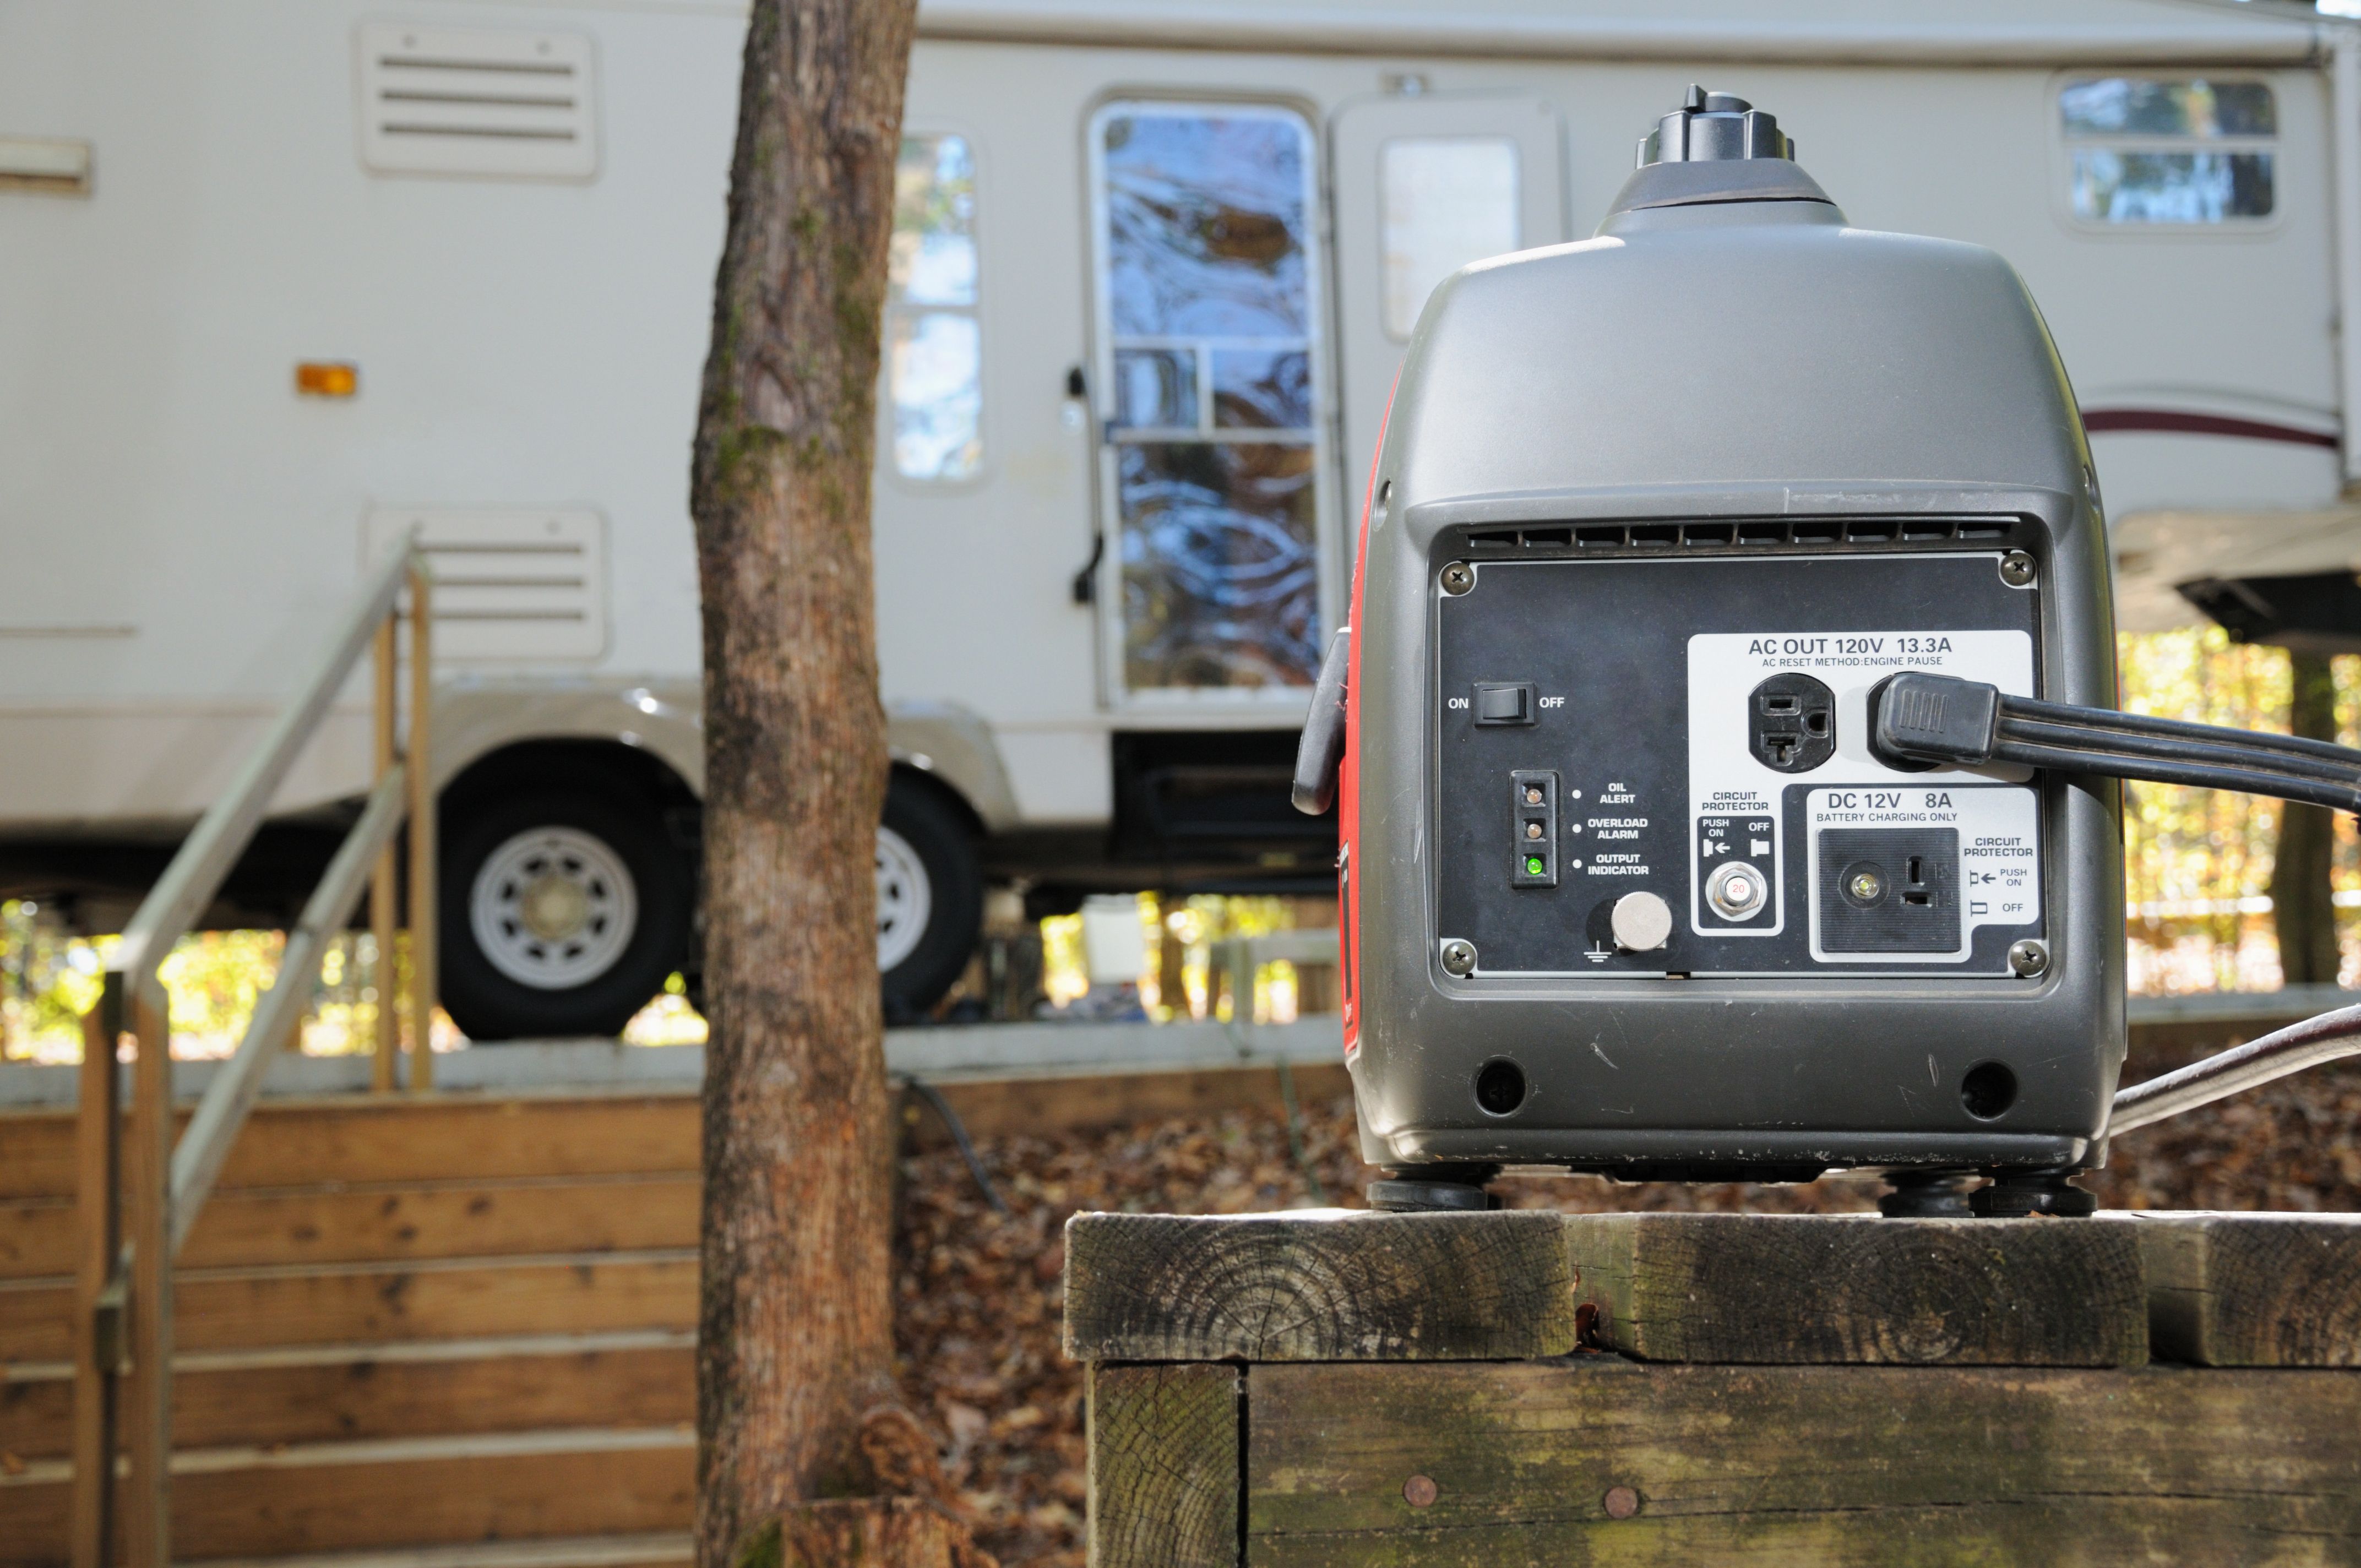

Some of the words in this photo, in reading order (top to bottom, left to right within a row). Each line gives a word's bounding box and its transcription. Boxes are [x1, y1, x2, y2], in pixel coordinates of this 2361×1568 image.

[1749, 639, 1777, 655] AC
[1783, 639, 1828, 655] OUT
[1835, 638, 1884, 654] 120V
[1897, 637, 1952, 653] 13.3A
[1762, 658, 1776, 667] AC
[1780, 658, 1811, 667] RESET
[1907, 656, 1943, 665] PAUSE
[1448, 698, 1469, 709] ON
[1539, 696, 1565, 708] OFF
[1608, 782, 1627, 792] OIL
[1600, 794, 1636, 804] ALERT
[1712, 792, 1758, 801] CIRCUIT
[1828, 793, 1857, 809] DC
[1864, 793, 1901, 808] 12V
[1925, 792, 1952, 808] 8A
[1702, 802, 1769, 810] PROTECTOR
[1816, 813, 1864, 822] BATTERY
[1868, 813, 1927, 821] CHARGING
[1930, 813, 1957, 821] ONLY
[1587, 818, 1648, 828] OVERLOAD
[1702, 819, 1729, 827] PUSH
[1748, 822, 1770, 831] OFF
[1597, 830, 1639, 839] ALARM
[1708, 829, 1724, 837] ON
[1975, 837, 2021, 846] CIRCUIT
[1964, 848, 2033, 857] PROTECTOR
[1596, 854, 1641, 863] OUTPUT
[1588, 865, 1649, 875] INDICATOR
[2000, 868, 2027, 876] PUSH
[2006, 878, 2021, 886] ON
[1732, 884, 1745, 894] 20
[2002, 903, 2023, 912] OFF
